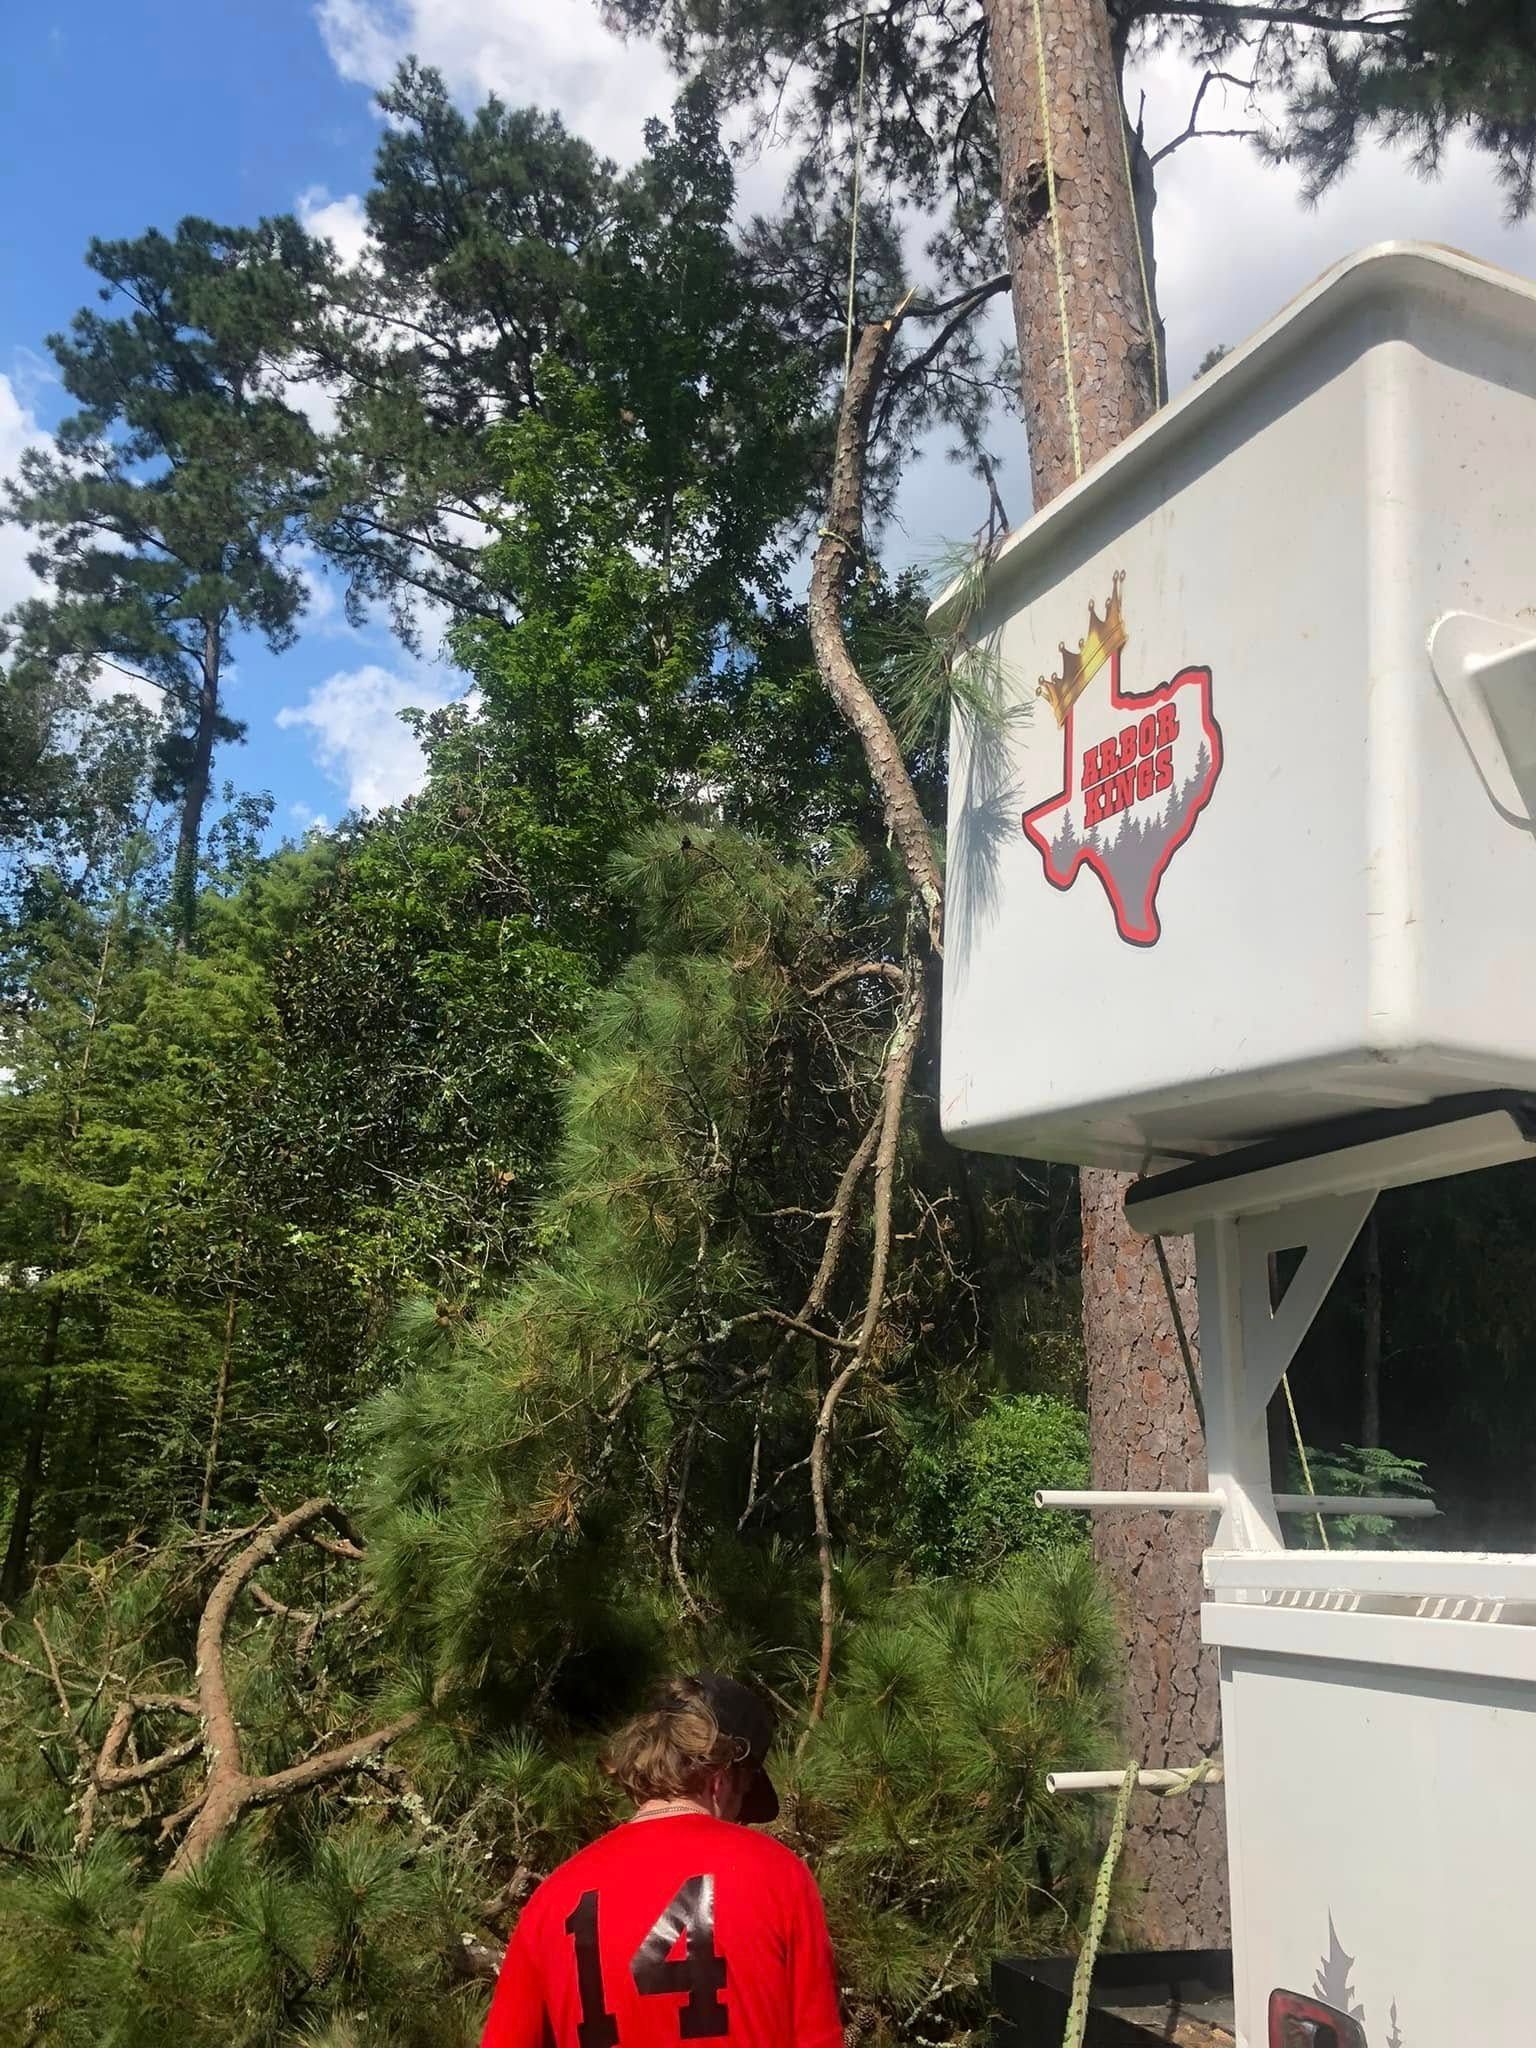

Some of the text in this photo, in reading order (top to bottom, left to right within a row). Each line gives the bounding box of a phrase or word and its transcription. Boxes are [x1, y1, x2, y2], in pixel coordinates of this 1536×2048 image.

[1081, 702, 1180, 791] ARBOR
[1083, 745, 1174, 829] KINGS
[565, 1873, 730, 2048] 14
